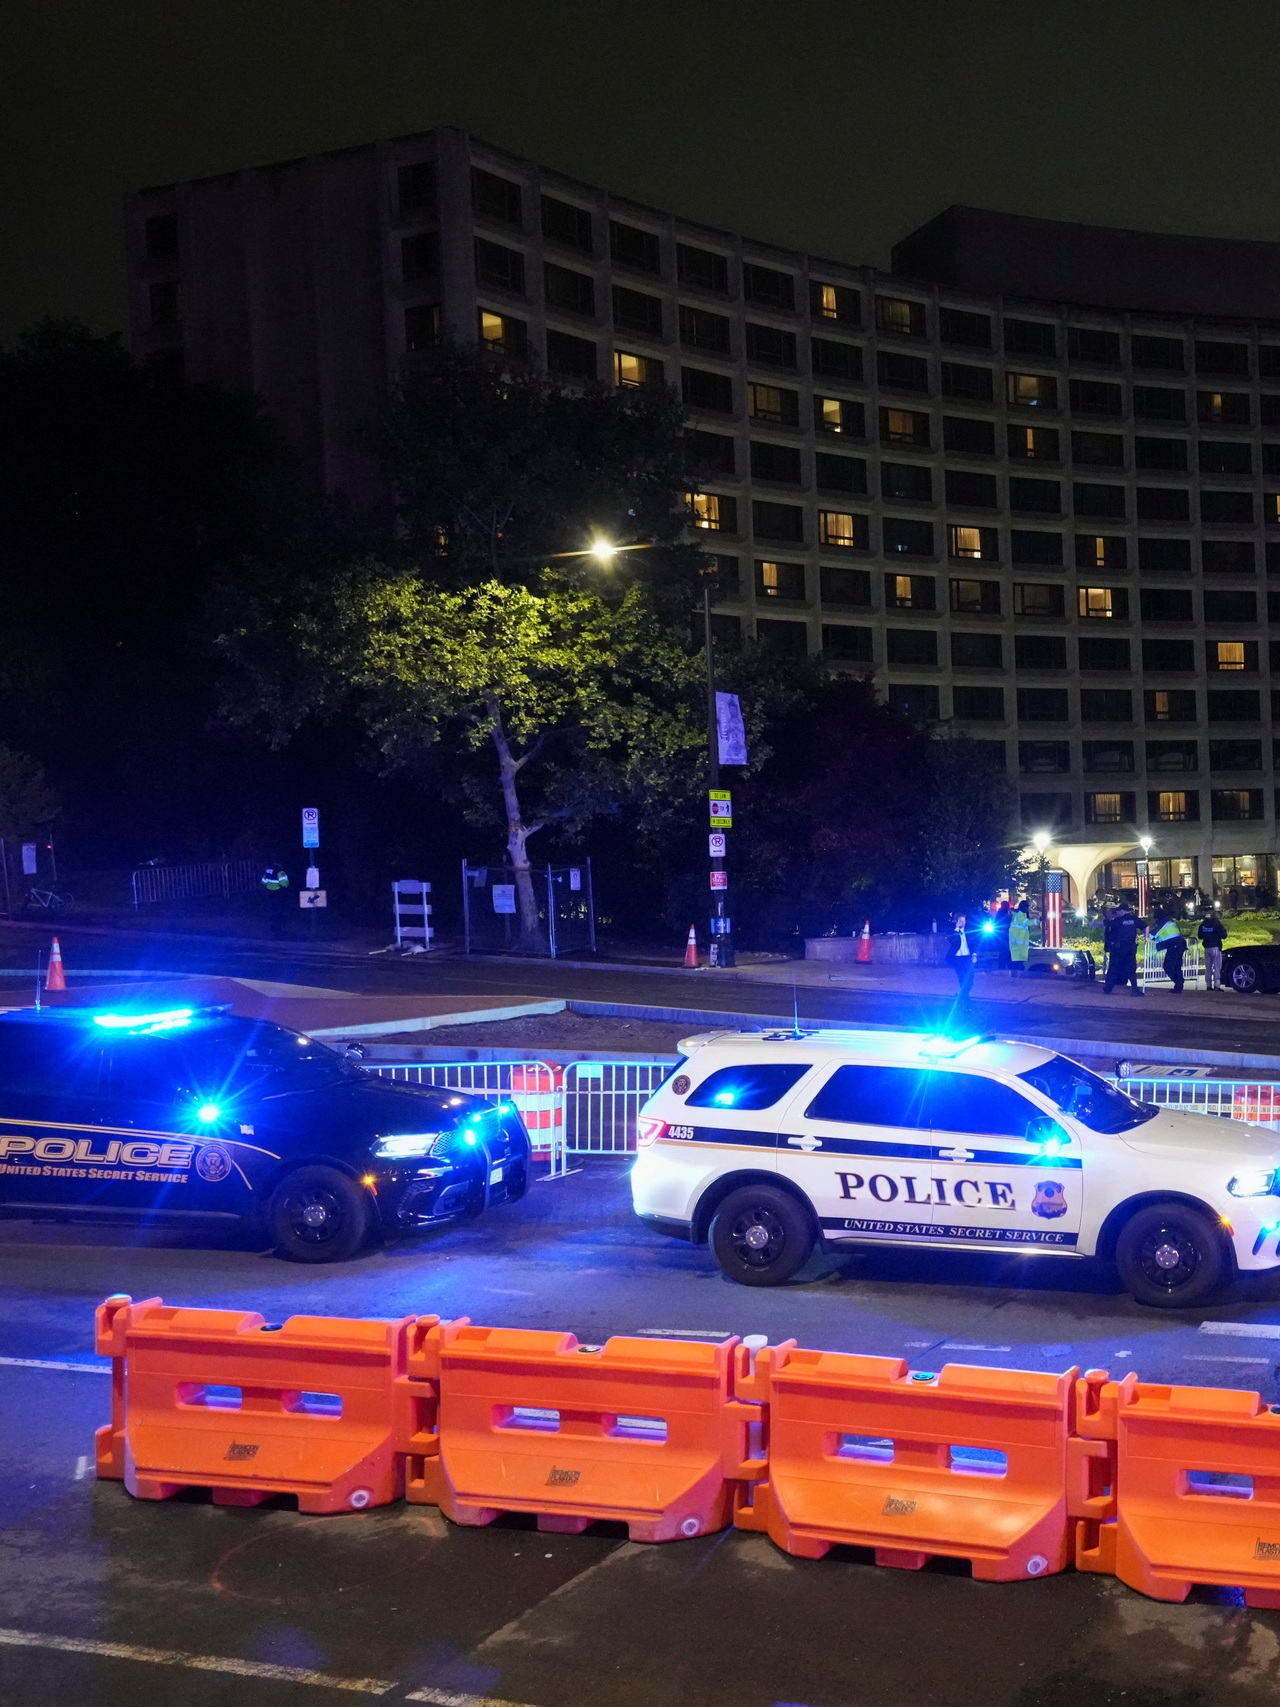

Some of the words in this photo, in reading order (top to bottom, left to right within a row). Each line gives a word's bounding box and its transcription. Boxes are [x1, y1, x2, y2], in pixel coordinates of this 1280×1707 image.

[668, 1126, 694, 1139] 4435
[0, 1135, 195, 1169] POLICE
[0, 1164, 40, 1176] UNITED
[42, 1165, 86, 1178] STATES
[88, 1168, 133, 1181] SECRET
[135, 1170, 188, 1184] SERVICE
[834, 1172, 1017, 1211] POLICE
[844, 1219, 894, 1232] UNITED
[896, 1223, 944, 1236] STATES
[949, 1228, 1002, 1240] SECRET
[1004, 1231, 1064, 1244] SERVICE
